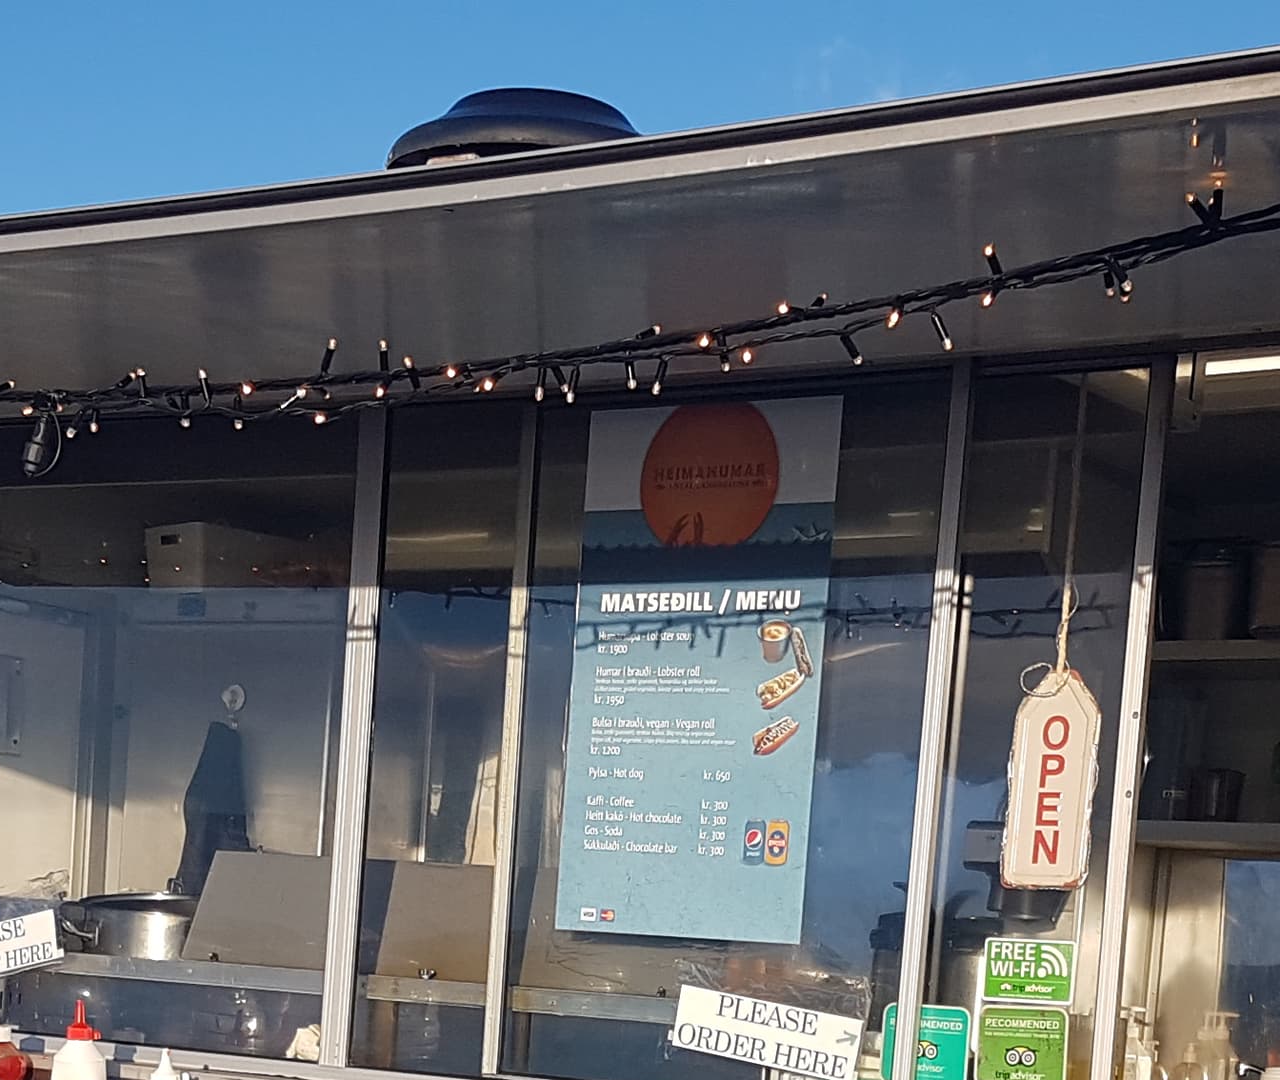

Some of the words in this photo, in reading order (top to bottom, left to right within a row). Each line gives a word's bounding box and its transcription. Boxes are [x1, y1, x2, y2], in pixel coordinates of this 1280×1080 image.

[656, 463, 765, 482] HEIMAHUMAR
[600, 591, 713, 612] MATSEÐILL
[735, 590, 801, 611] MENU
[596, 666, 620, 677] Humar
[658, 666, 685, 677] Lobster
[687, 666, 700, 677] roll
[593, 694, 604, 704] kr.
[606, 696, 625, 706] 1950
[646, 720, 669, 731] vegan
[675, 718, 700, 731] Vegan
[701, 718, 715, 729] roll
[590, 745, 600, 755] kr.
[588, 767, 608, 780] Pylsa
[613, 768, 627, 779] Hot
[628, 767, 644, 781] dog
[703, 769, 714, 780] kr.
[715, 770, 731, 782] 650
[1031, 715, 1070, 864] OPEN
[586, 795, 604, 806] Kaffi
[609, 796, 635, 807] Coffee
[701, 799, 712, 810] kr.
[713, 800, 729, 811] 300
[630, 812, 644, 822] Hot
[645, 812, 682, 824] chocolate
[700, 814, 711, 825] kr.
[712, 815, 727, 826] 300
[604, 826, 623, 837] Soda
[699, 829, 710, 840] kr.
[710, 830, 726, 841] 300
[625, 841, 664, 853] Chocolate
[664, 842, 678, 854] bar
[698, 844, 708, 855] kr.
[709, 845, 725, 856] 300
[6, 942, 53, 969] HERE
[991, 942, 1037, 961] FREE
[990, 961, 1036, 978] WI-FI
[1013, 984, 1053, 993] tripadvisor
[716, 994, 818, 1036] PLEASE
[984, 1018, 1060, 1030] RECOMMENDED
[678, 1023, 766, 1061] ORDER
[772, 1042, 848, 1079] HERE
[995, 1070, 1042, 1080] tripadvisor
